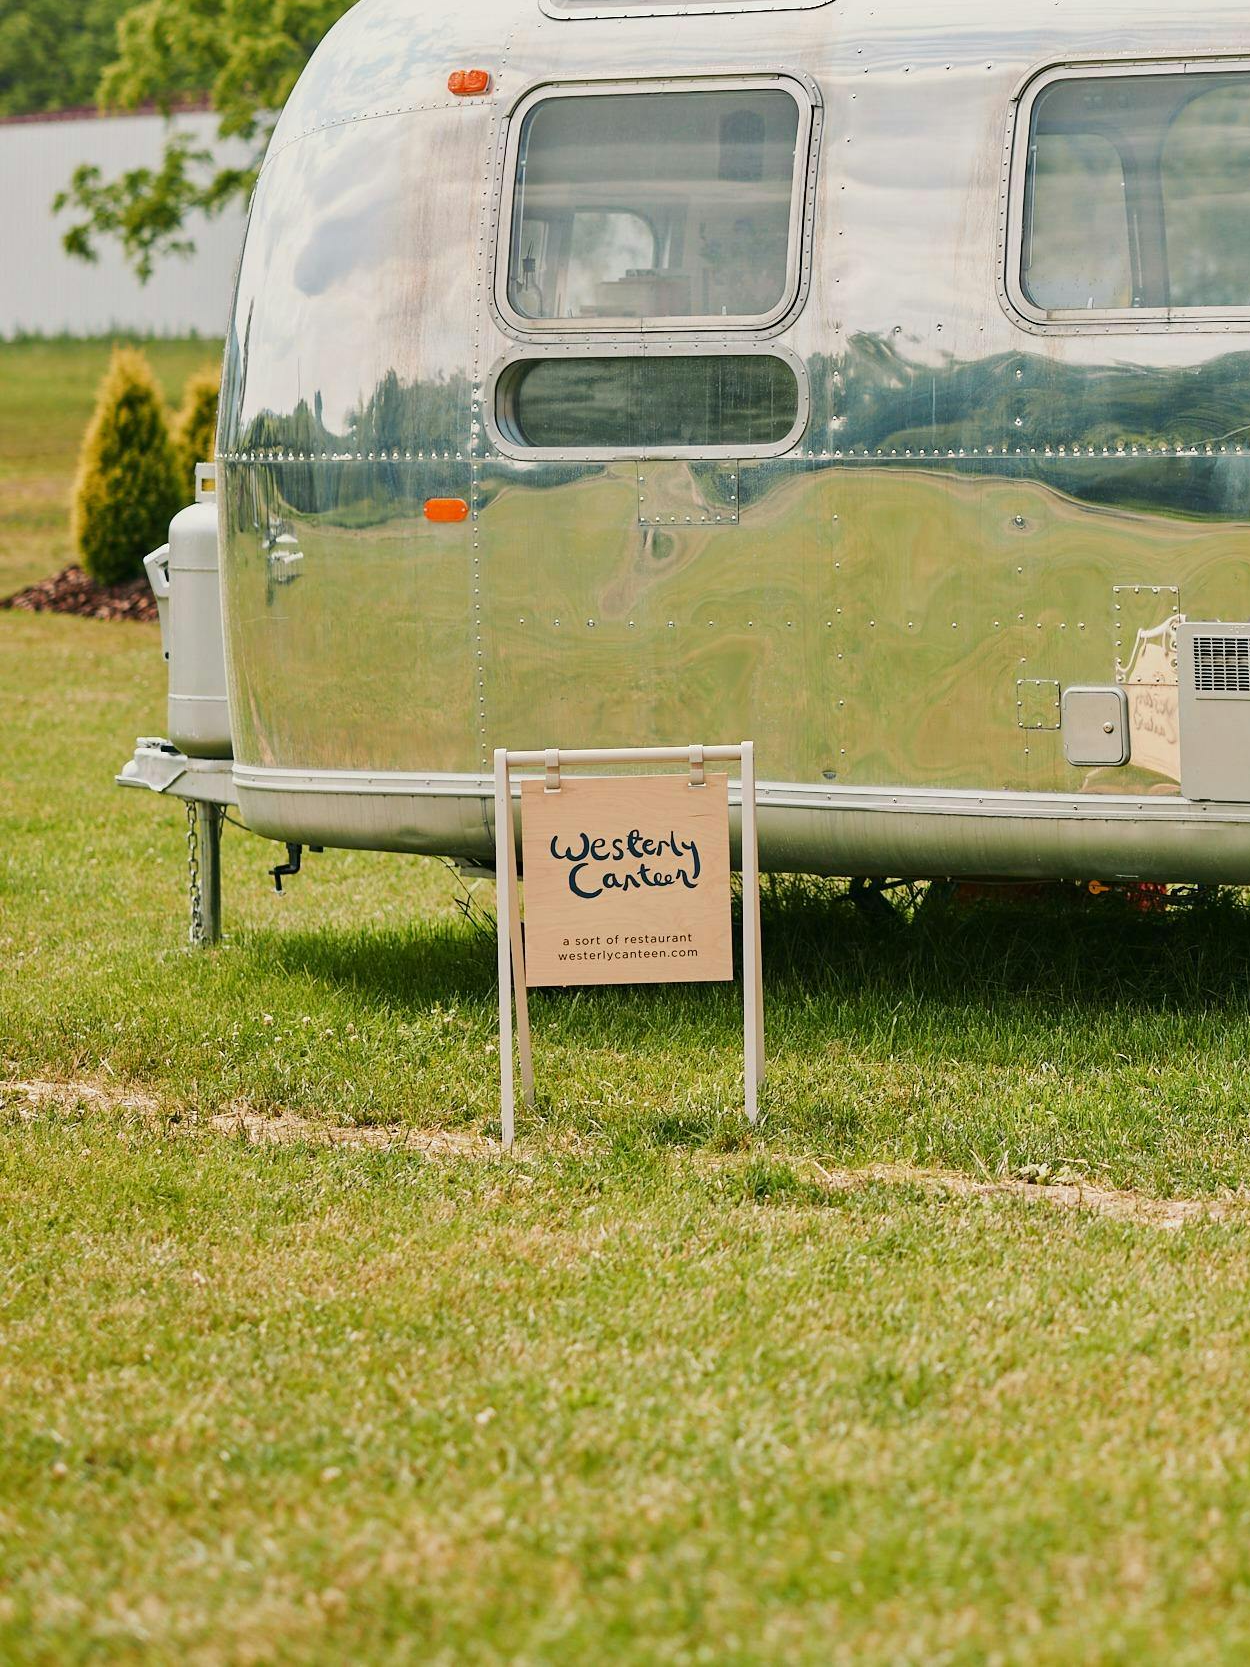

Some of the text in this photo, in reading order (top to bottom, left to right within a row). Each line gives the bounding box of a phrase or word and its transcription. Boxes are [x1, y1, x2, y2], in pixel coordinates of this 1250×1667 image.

[550, 829, 701, 880] Westerly
[568, 862, 699, 899] Canteen
[562, 934, 693, 946] a sort of restaurant
[558, 948, 698, 961] westerlycanteen.com
